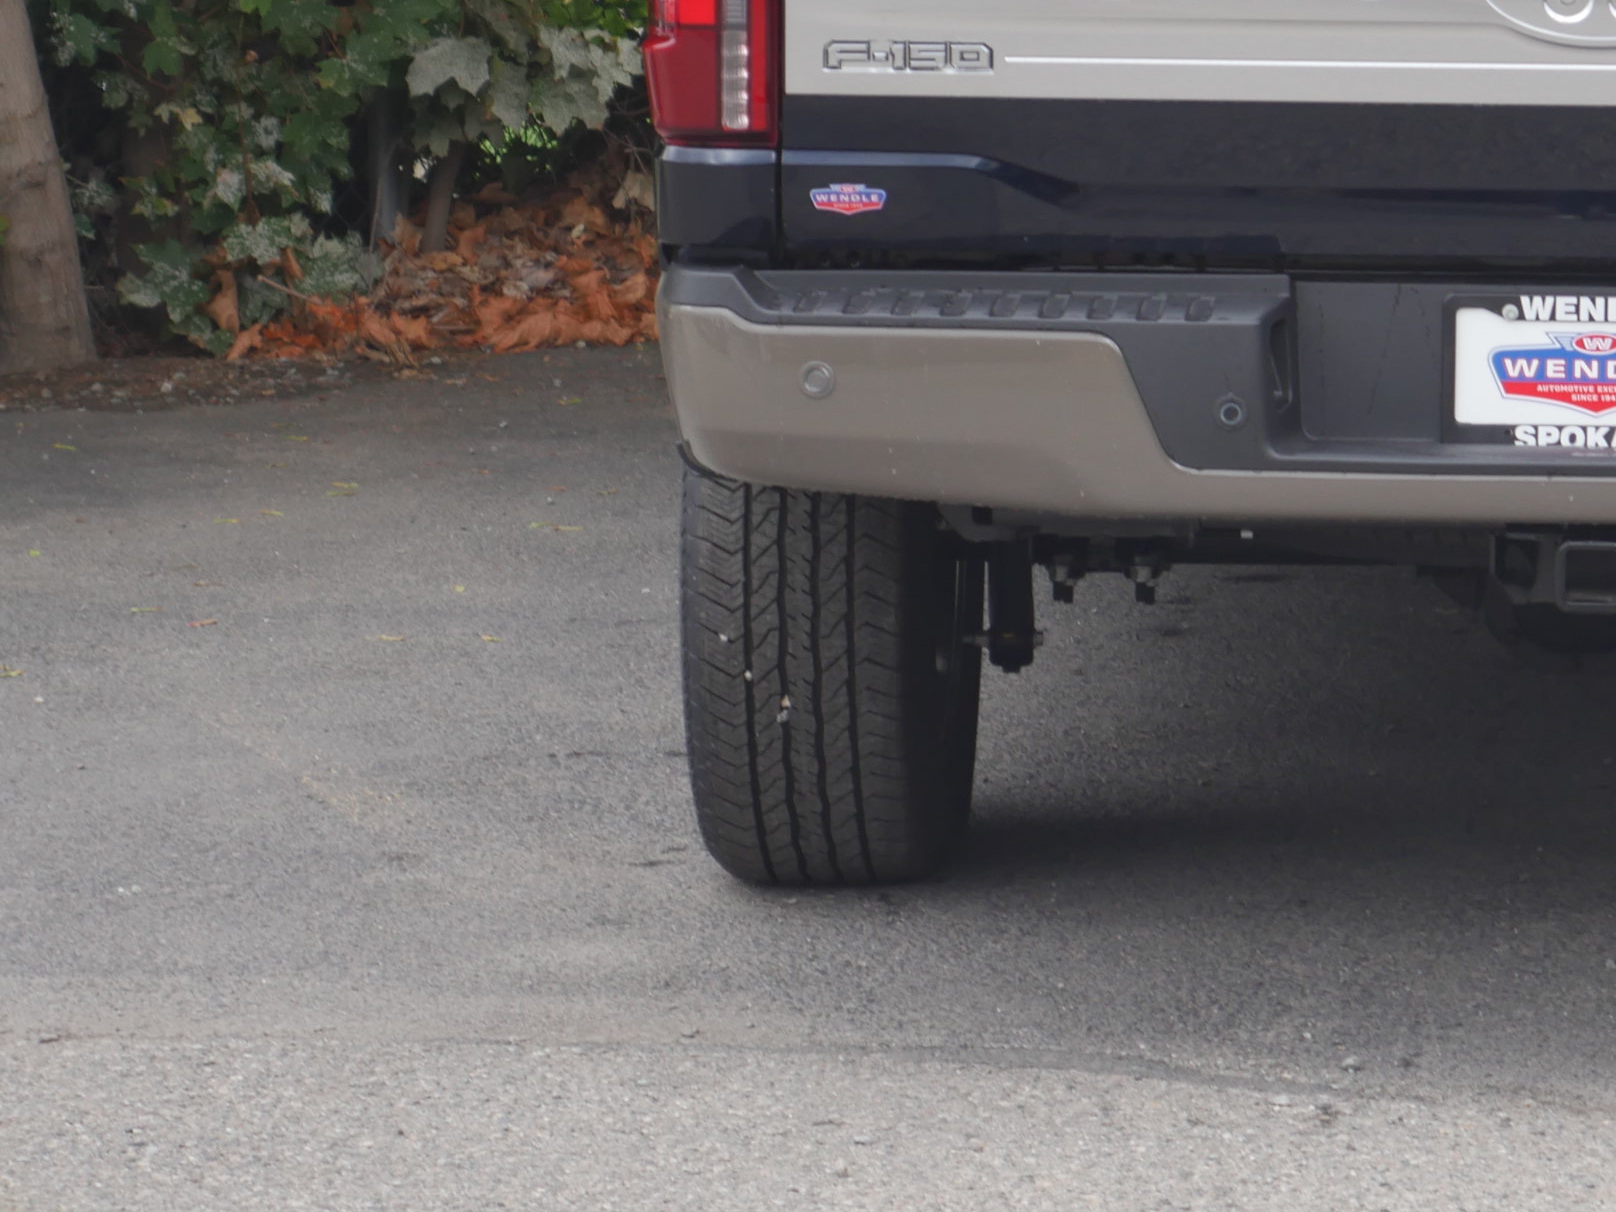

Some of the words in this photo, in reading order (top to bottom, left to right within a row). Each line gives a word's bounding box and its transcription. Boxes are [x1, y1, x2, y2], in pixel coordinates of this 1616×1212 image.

[823, 40, 995, 73] F-150
[816, 193, 879, 202] WENDLE
[1537, 384, 1594, 394] AUTOMOTIVE
[1571, 393, 1598, 402] SINCE
